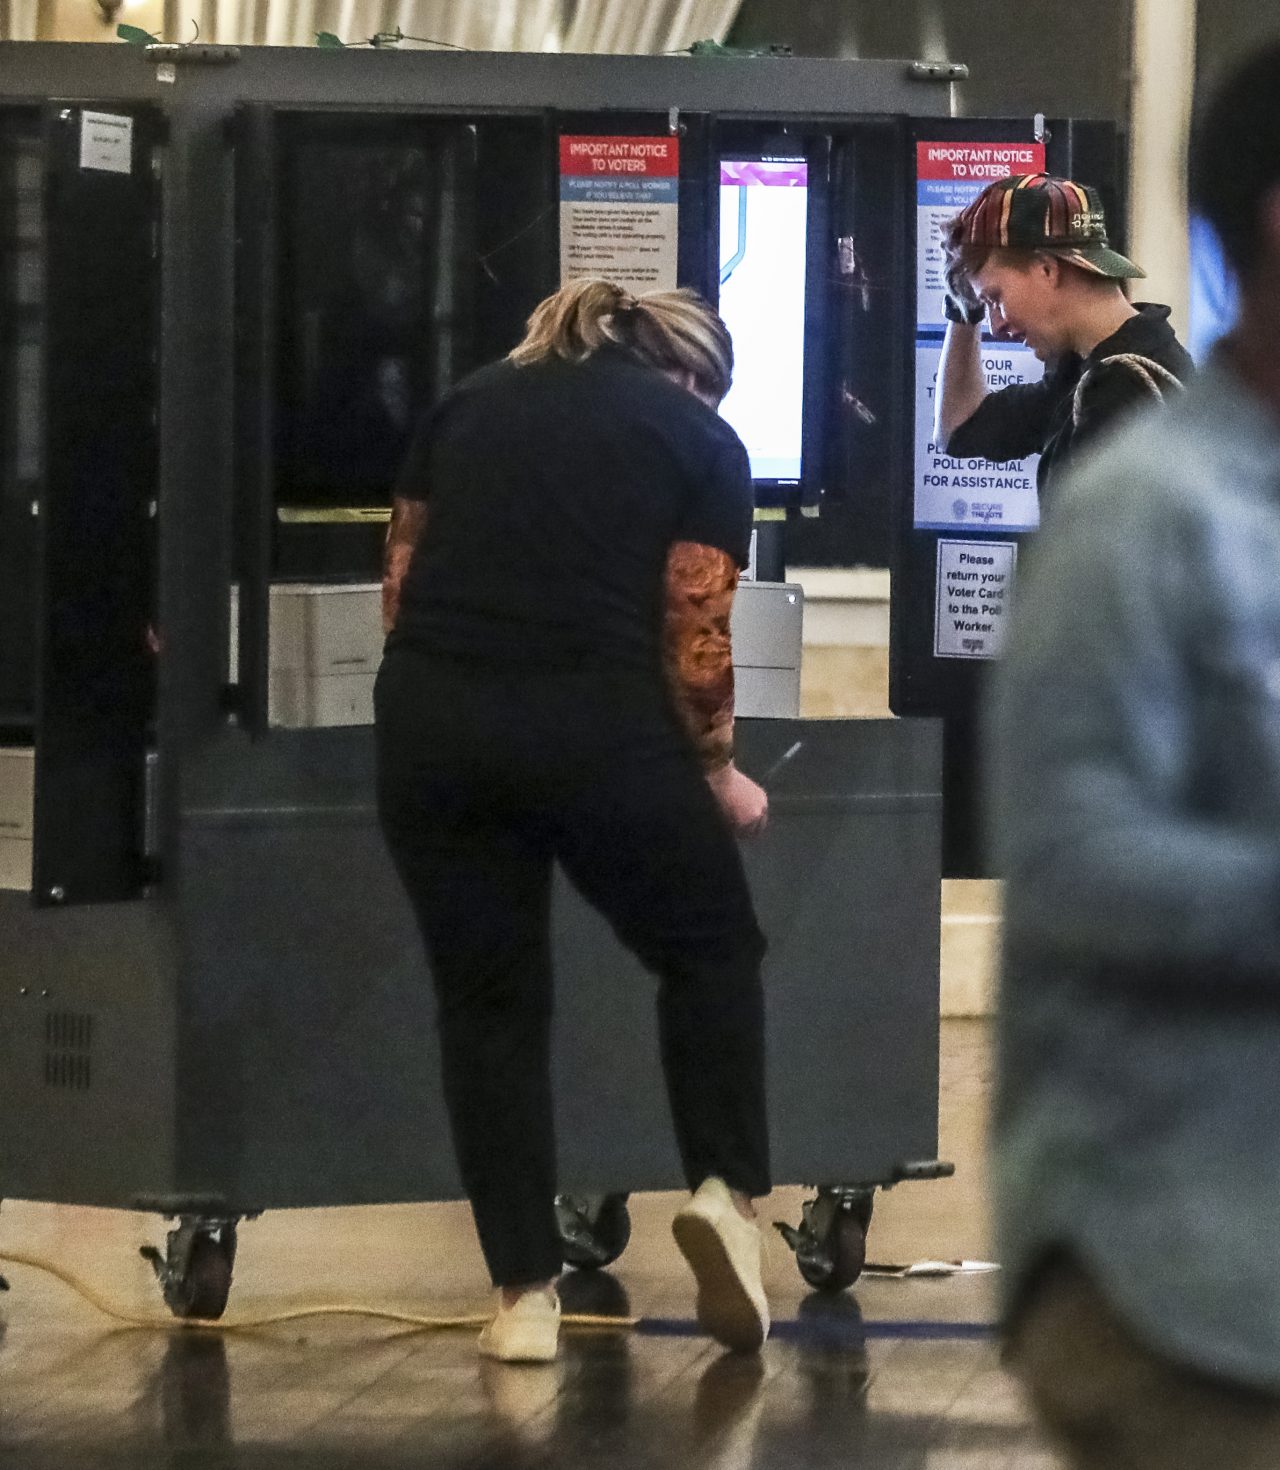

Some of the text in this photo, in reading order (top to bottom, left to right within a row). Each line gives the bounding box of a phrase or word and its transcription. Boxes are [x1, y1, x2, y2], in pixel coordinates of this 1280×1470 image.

[570, 144, 667, 157] IMPORTANT NOTICE
[928, 149, 1033, 162] IMPORTANT NOTICE
[593, 159, 646, 172] TO VOTERS
[952, 164, 1010, 176] TO VOTERS
[927, 185, 952, 193] PLEASE
[983, 360, 1012, 371] OUR
[933, 459, 1023, 472] POLL OFFICIAL
[923, 475, 1032, 489] FOR ASSISTANCE.
[960, 553, 994, 565] Please
[947, 571, 1005, 584] return your
[948, 586, 1003, 598] Voter Card
[948, 604, 1002, 615] to the Poll
[954, 620, 995, 632] Worker.
